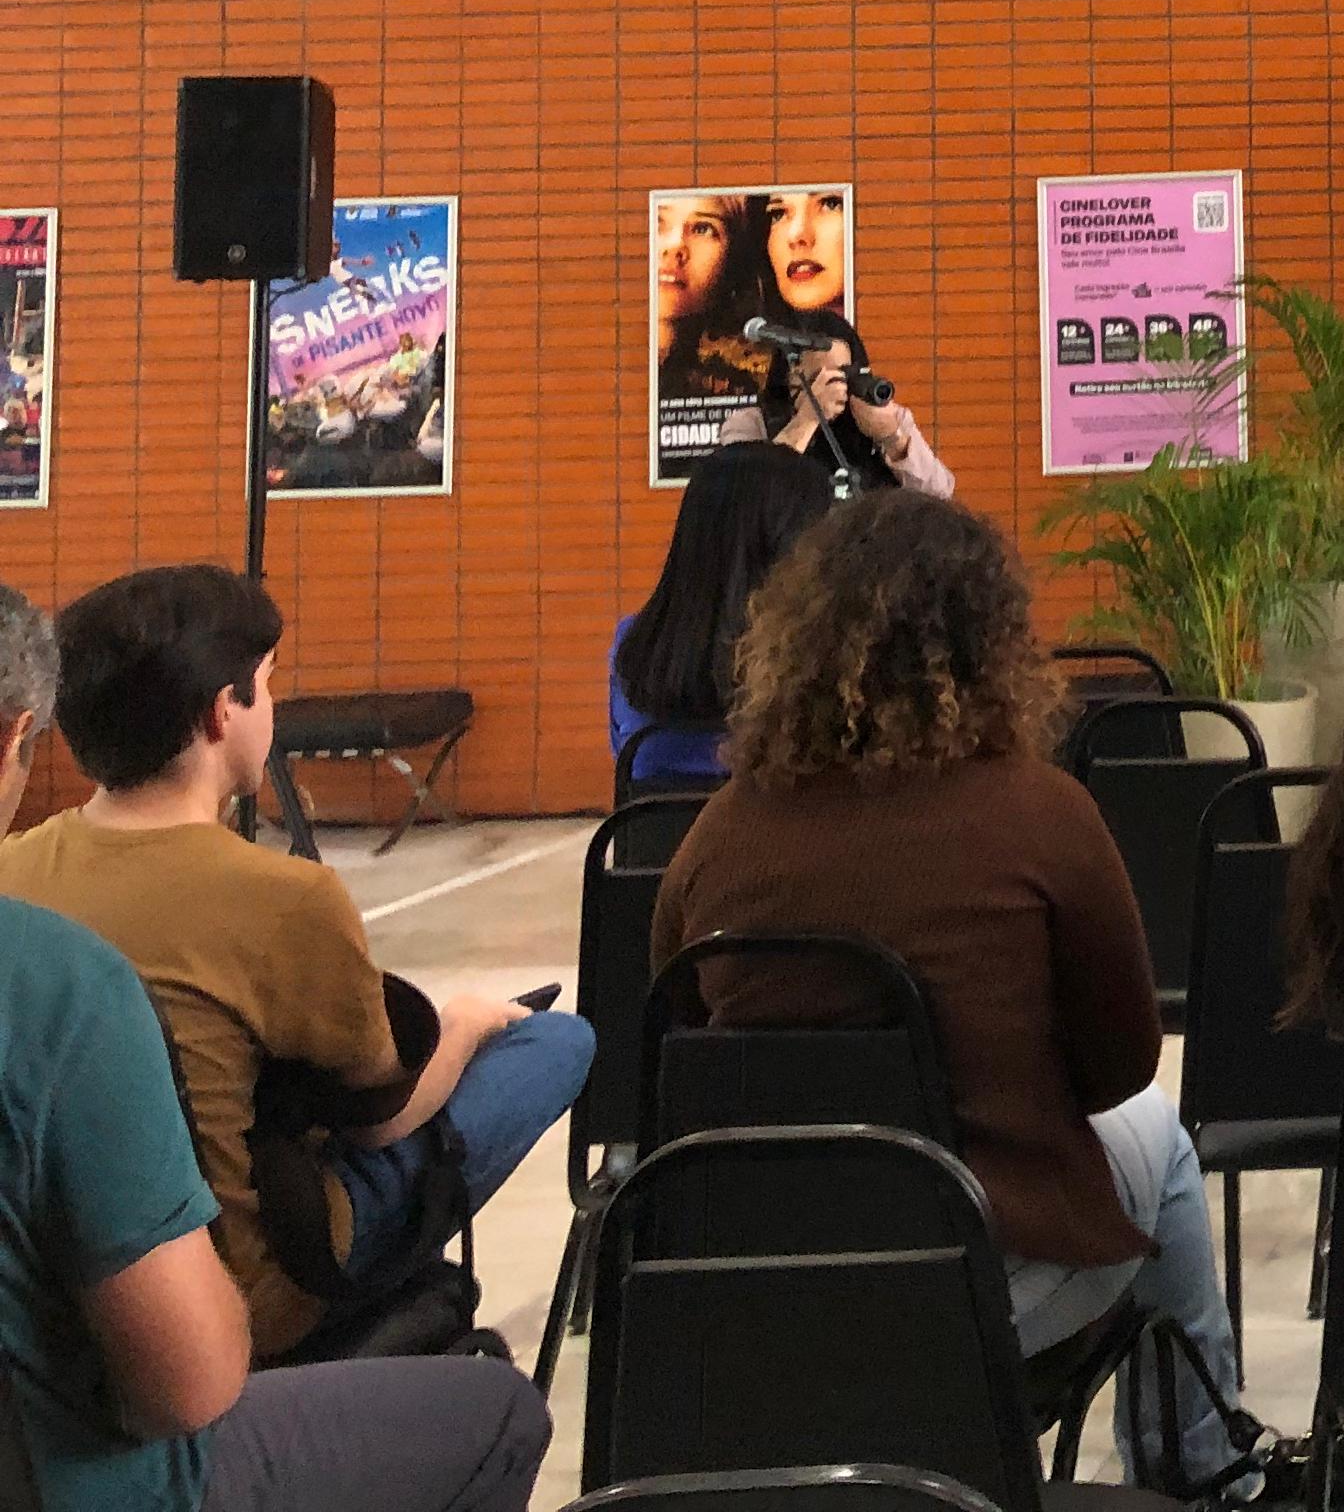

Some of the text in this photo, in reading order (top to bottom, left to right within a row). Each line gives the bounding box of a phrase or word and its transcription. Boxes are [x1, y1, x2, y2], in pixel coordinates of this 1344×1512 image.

[1060, 196, 1152, 213] CINELOVER
[1060, 213, 1155, 229] PROGRAMA
[1061, 227, 1179, 245] DE FIDELIDADE
[660, 423, 720, 447] CIDADE
